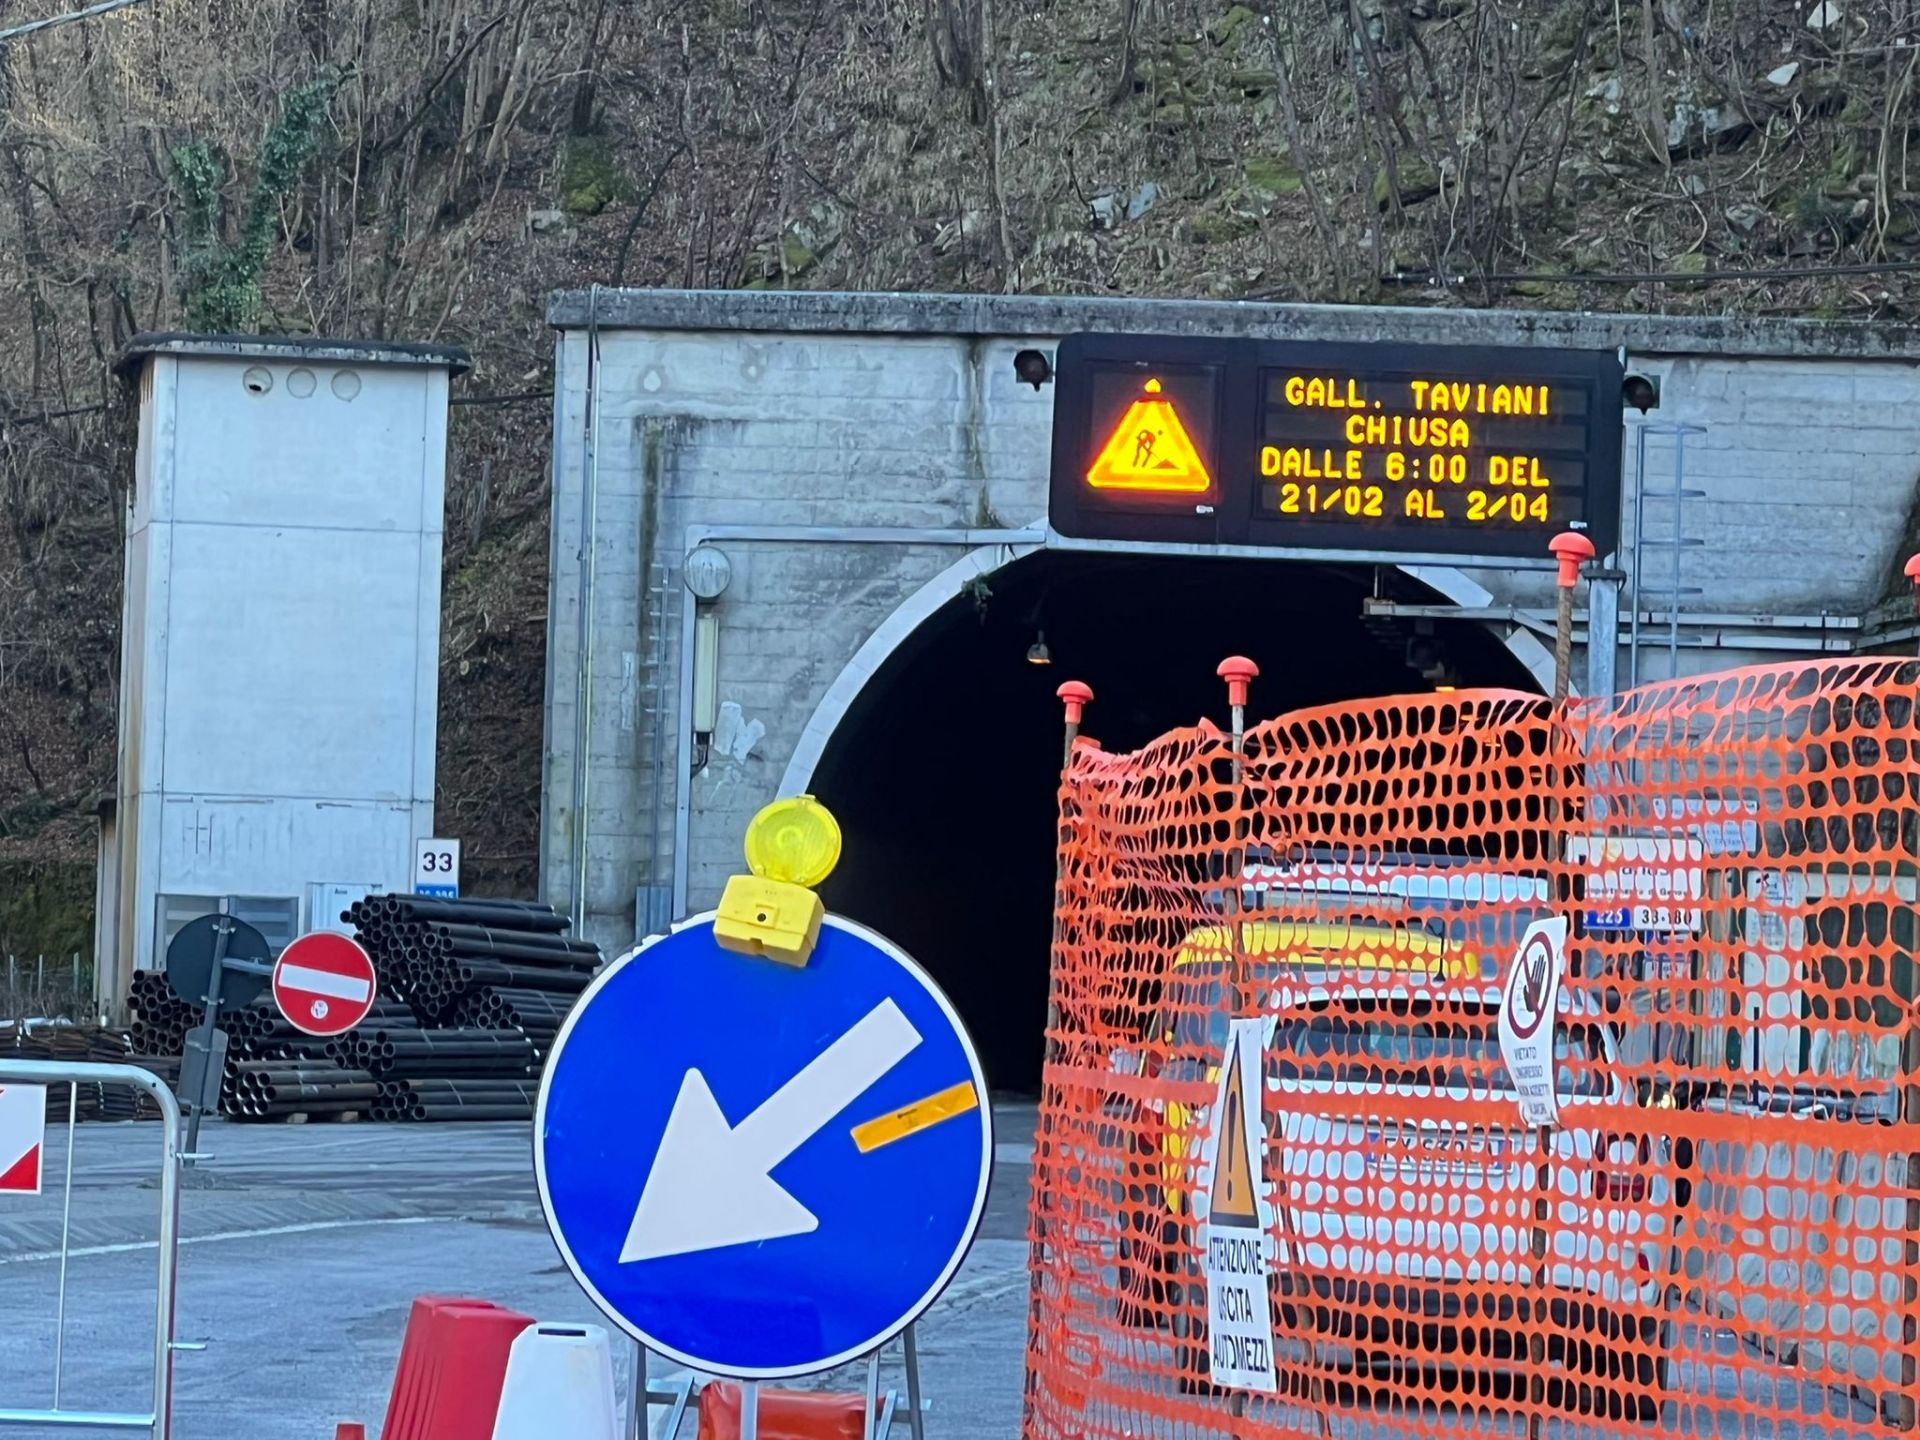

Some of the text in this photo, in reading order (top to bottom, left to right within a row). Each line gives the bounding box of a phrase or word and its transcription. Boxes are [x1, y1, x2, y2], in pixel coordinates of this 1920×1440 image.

[1285, 377, 1549, 415] GALL. TAVIANI
[1346, 415, 1469, 447] CHIUSA
[1261, 446, 1549, 487] DALLE 6:00 DEL
[1280, 484, 1549, 522] 21/02 AL 2/04
[423, 852, 452, 872] 33
[1513, 1046, 1537, 1061] VIETATO
[1208, 1236, 1263, 1275] ATTENZIONE
[1217, 1285, 1254, 1323] USCITA
